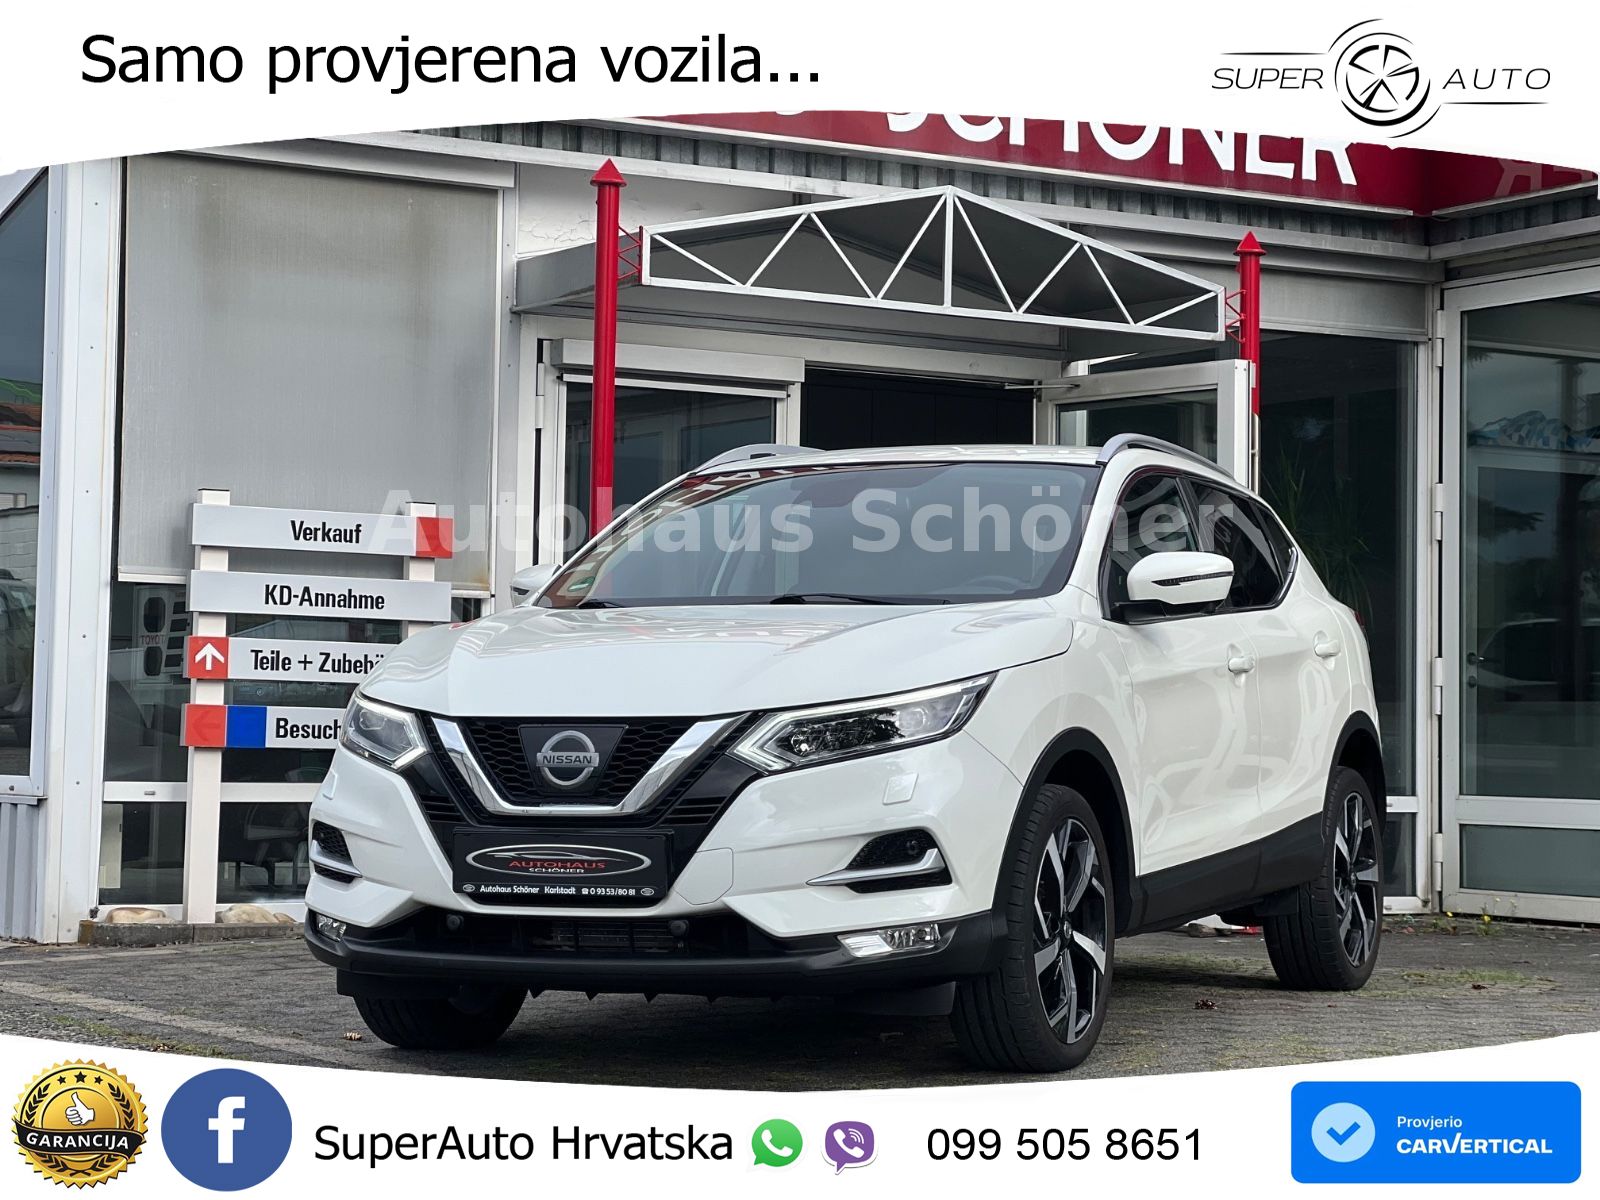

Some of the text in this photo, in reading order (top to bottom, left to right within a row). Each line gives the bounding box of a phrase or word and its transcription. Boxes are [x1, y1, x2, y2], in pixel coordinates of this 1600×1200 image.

[290, 520, 363, 545] Verkauf
[264, 584, 386, 611] KD-Annahme
[250, 649, 292, 672] Teile
[542, 754, 593, 766] NISSAN
[507, 860, 607, 869] AUTOHAUS
[479, 884, 512, 894] Autohaus
[513, 885, 540, 895] Schöner
[544, 886, 577, 896] Karlstadt
